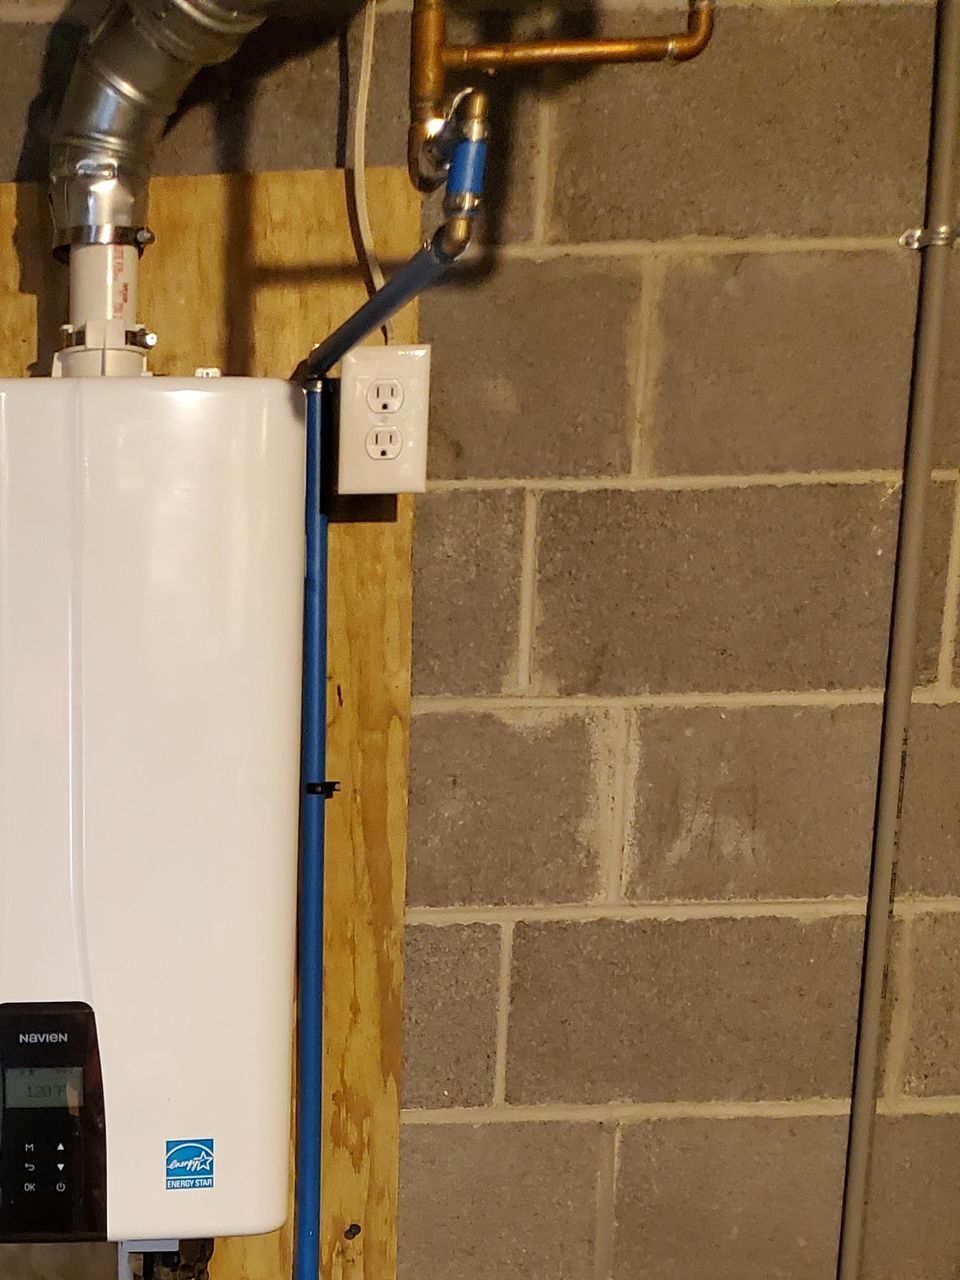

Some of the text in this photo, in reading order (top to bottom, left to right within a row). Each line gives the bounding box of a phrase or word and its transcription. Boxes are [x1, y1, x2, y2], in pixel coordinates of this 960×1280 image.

[25, 1143, 34, 1152] M
[24, 1182, 36, 1192] OK
[167, 1178, 213, 1188] ENERGY STAR
